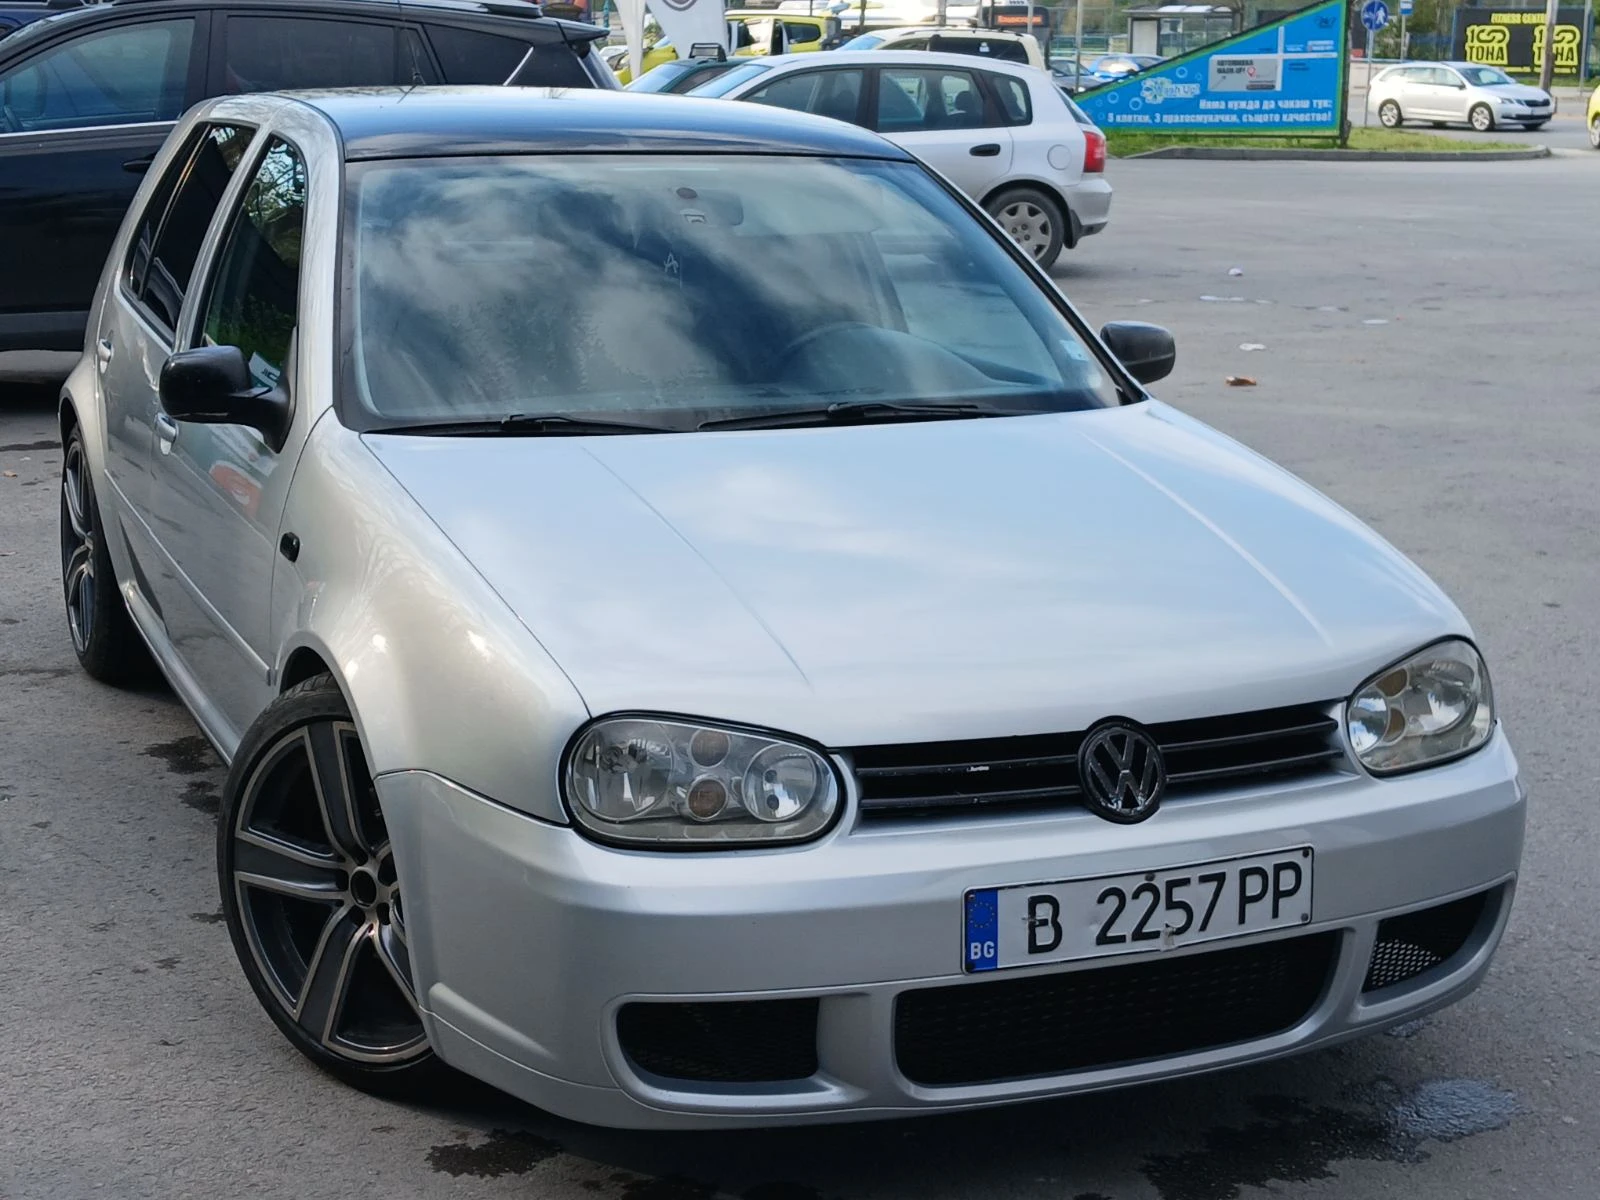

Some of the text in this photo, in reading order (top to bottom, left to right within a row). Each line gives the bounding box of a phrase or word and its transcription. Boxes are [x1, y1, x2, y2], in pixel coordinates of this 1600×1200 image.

[1468, 46, 1505, 61] ТОНА
[1537, 46, 1575, 61] ТНА
[1262, 100, 1276, 110] да
[1027, 860, 1303, 954] B 2257 PP
[970, 941, 995, 960] BG
